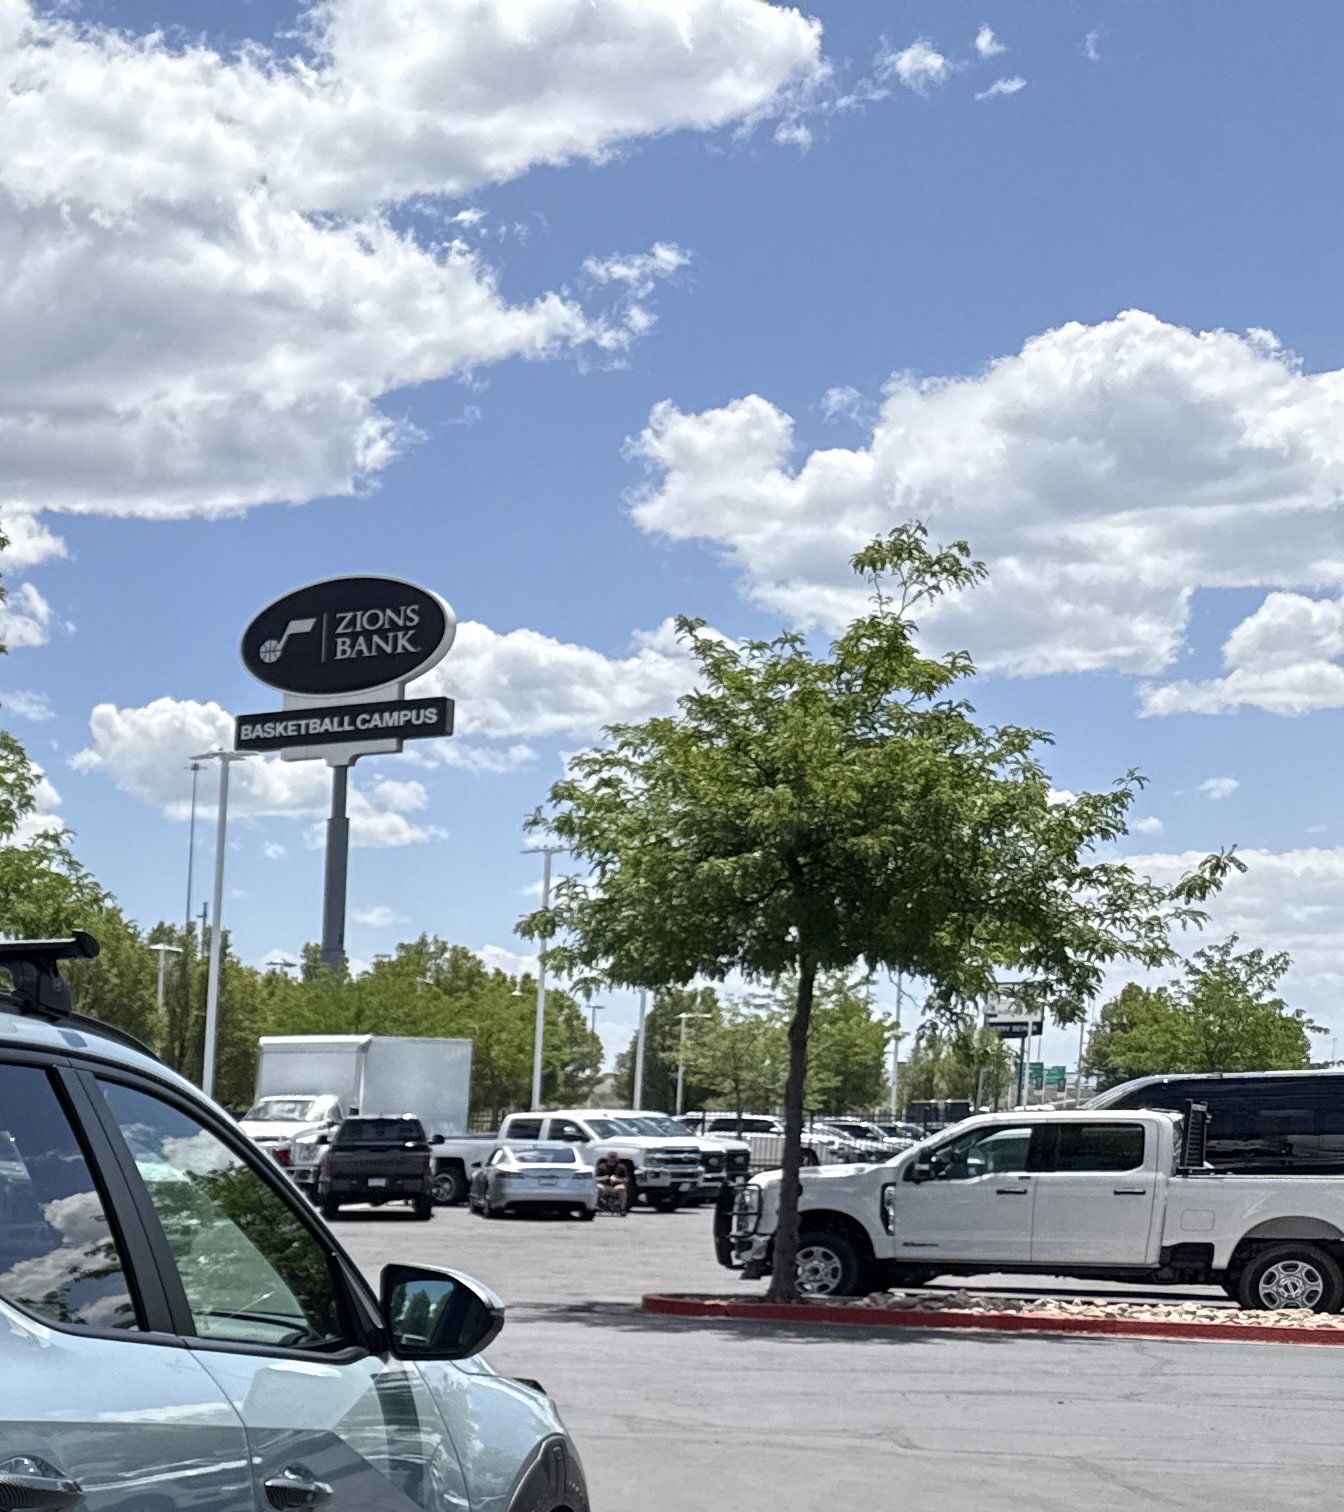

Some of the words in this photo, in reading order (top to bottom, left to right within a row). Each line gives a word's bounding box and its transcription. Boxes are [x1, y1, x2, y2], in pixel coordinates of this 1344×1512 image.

[335, 604, 420, 634] ZIONS
[334, 630, 419, 660] BANK
[240, 716, 355, 740] BASKETBALL
[356, 707, 438, 730] CAMPUS
